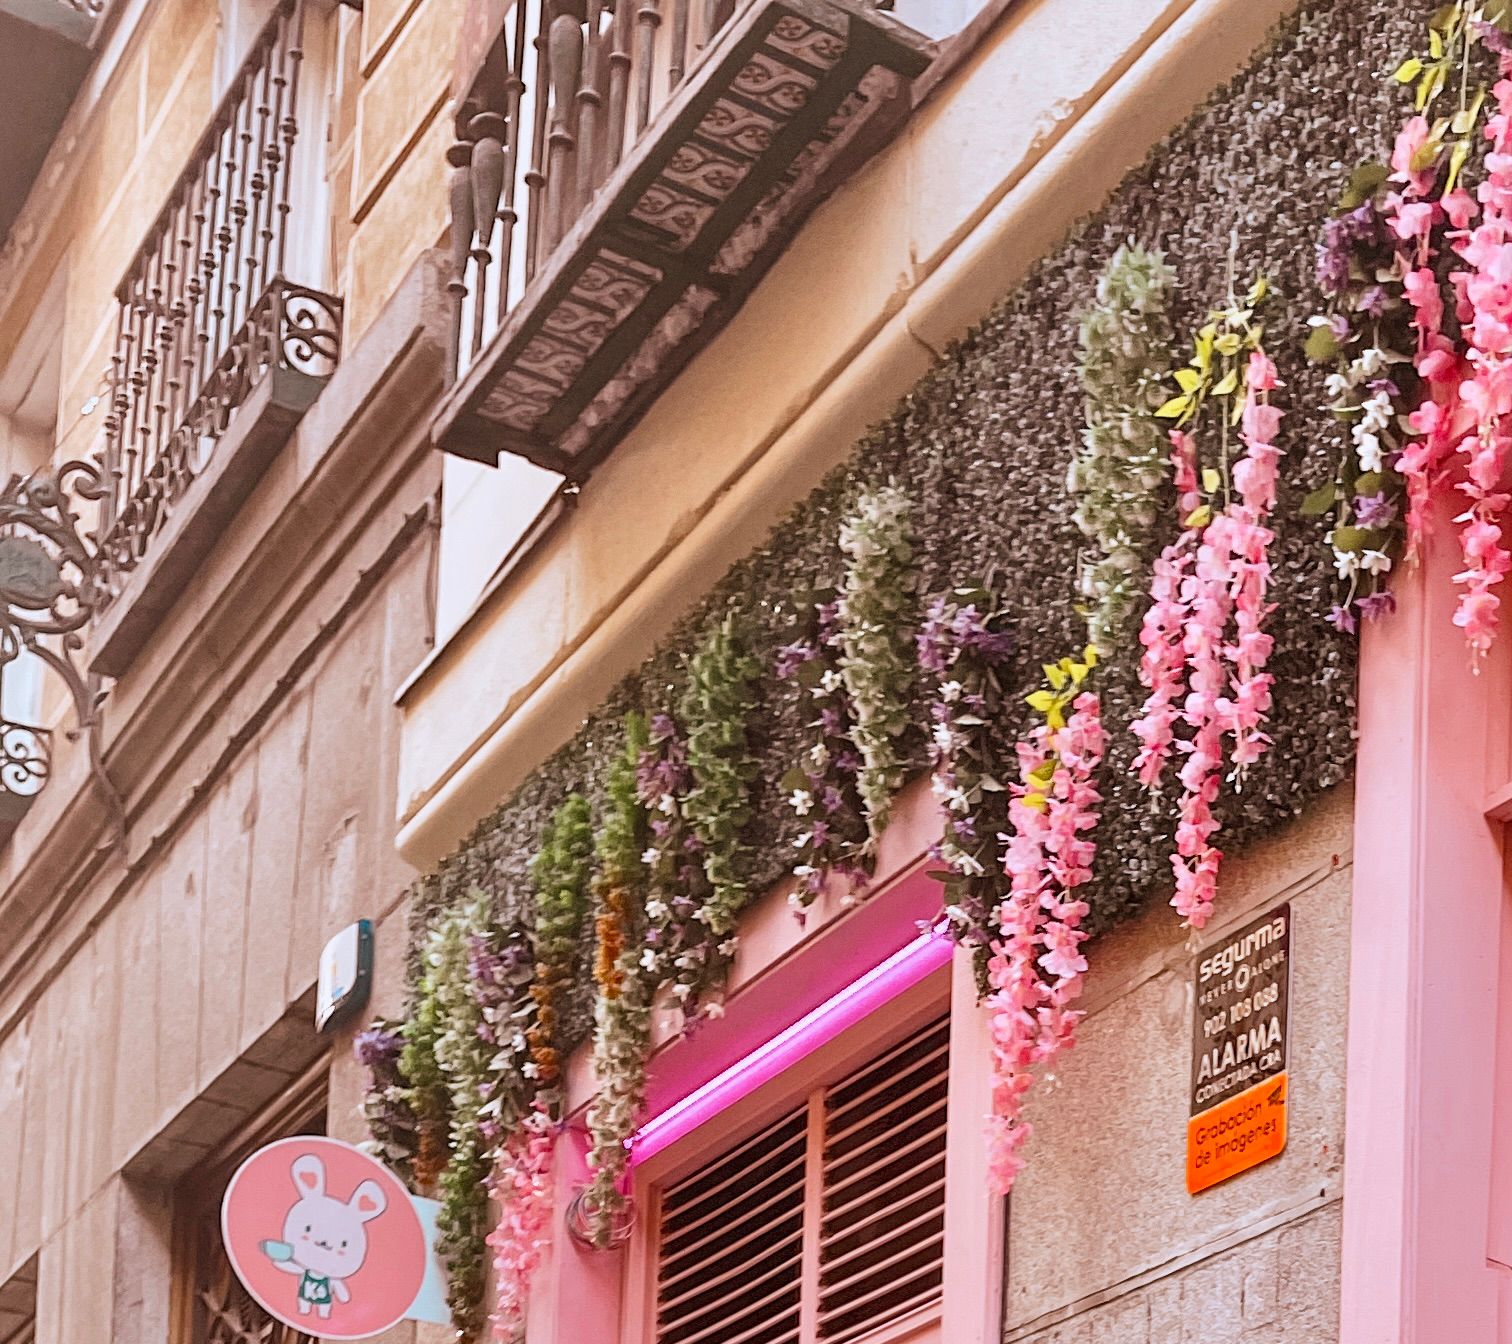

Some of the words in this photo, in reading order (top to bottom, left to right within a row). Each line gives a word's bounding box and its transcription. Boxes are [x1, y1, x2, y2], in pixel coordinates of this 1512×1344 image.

[1199, 916, 1286, 983] segurma
[1196, 1016, 1282, 1085] ALARMA
[1195, 1150, 1211, 1169] de
